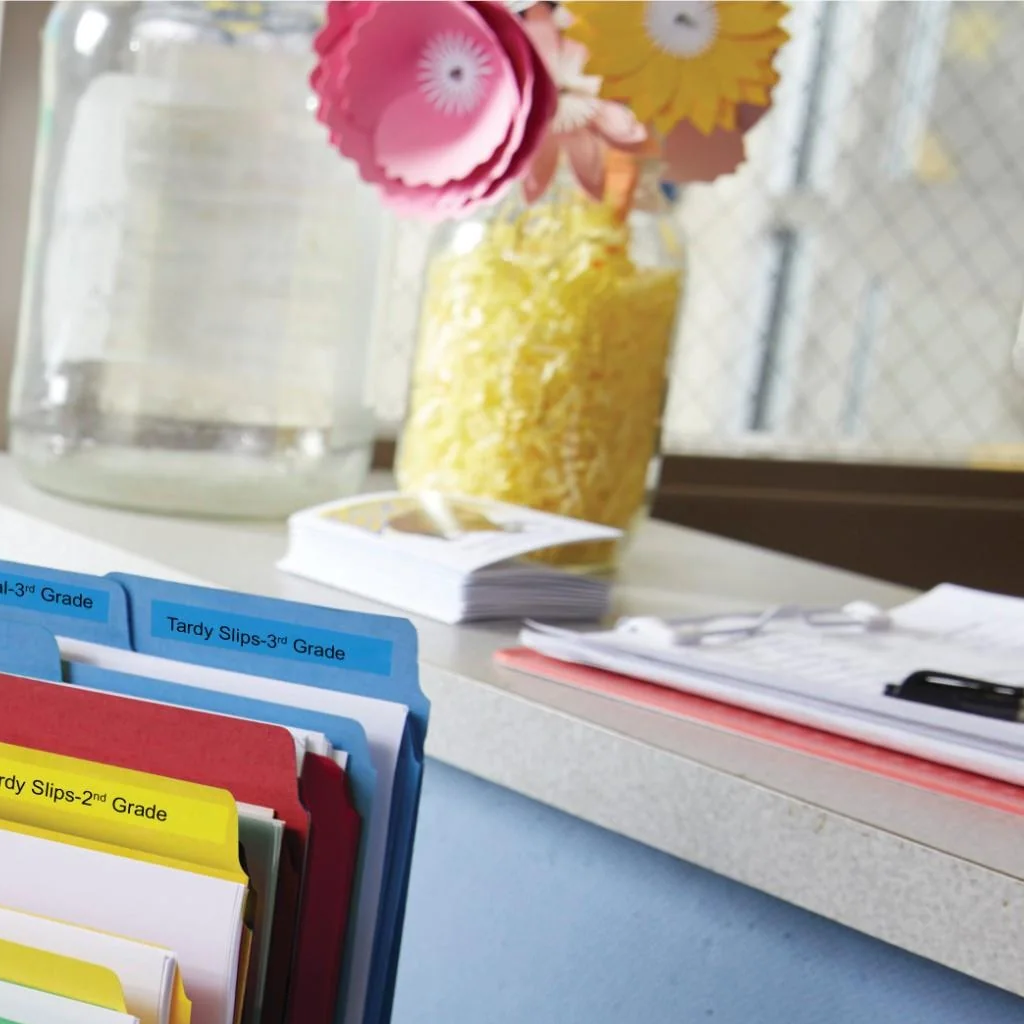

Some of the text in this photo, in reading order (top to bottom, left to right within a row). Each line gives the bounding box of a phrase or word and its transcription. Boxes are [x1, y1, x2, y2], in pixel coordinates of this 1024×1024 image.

[40, 587, 94, 609] Grade
[167, 616, 214, 640] Tardy
[293, 639, 346, 661] Grade
[112, 797, 168, 822] Grade
